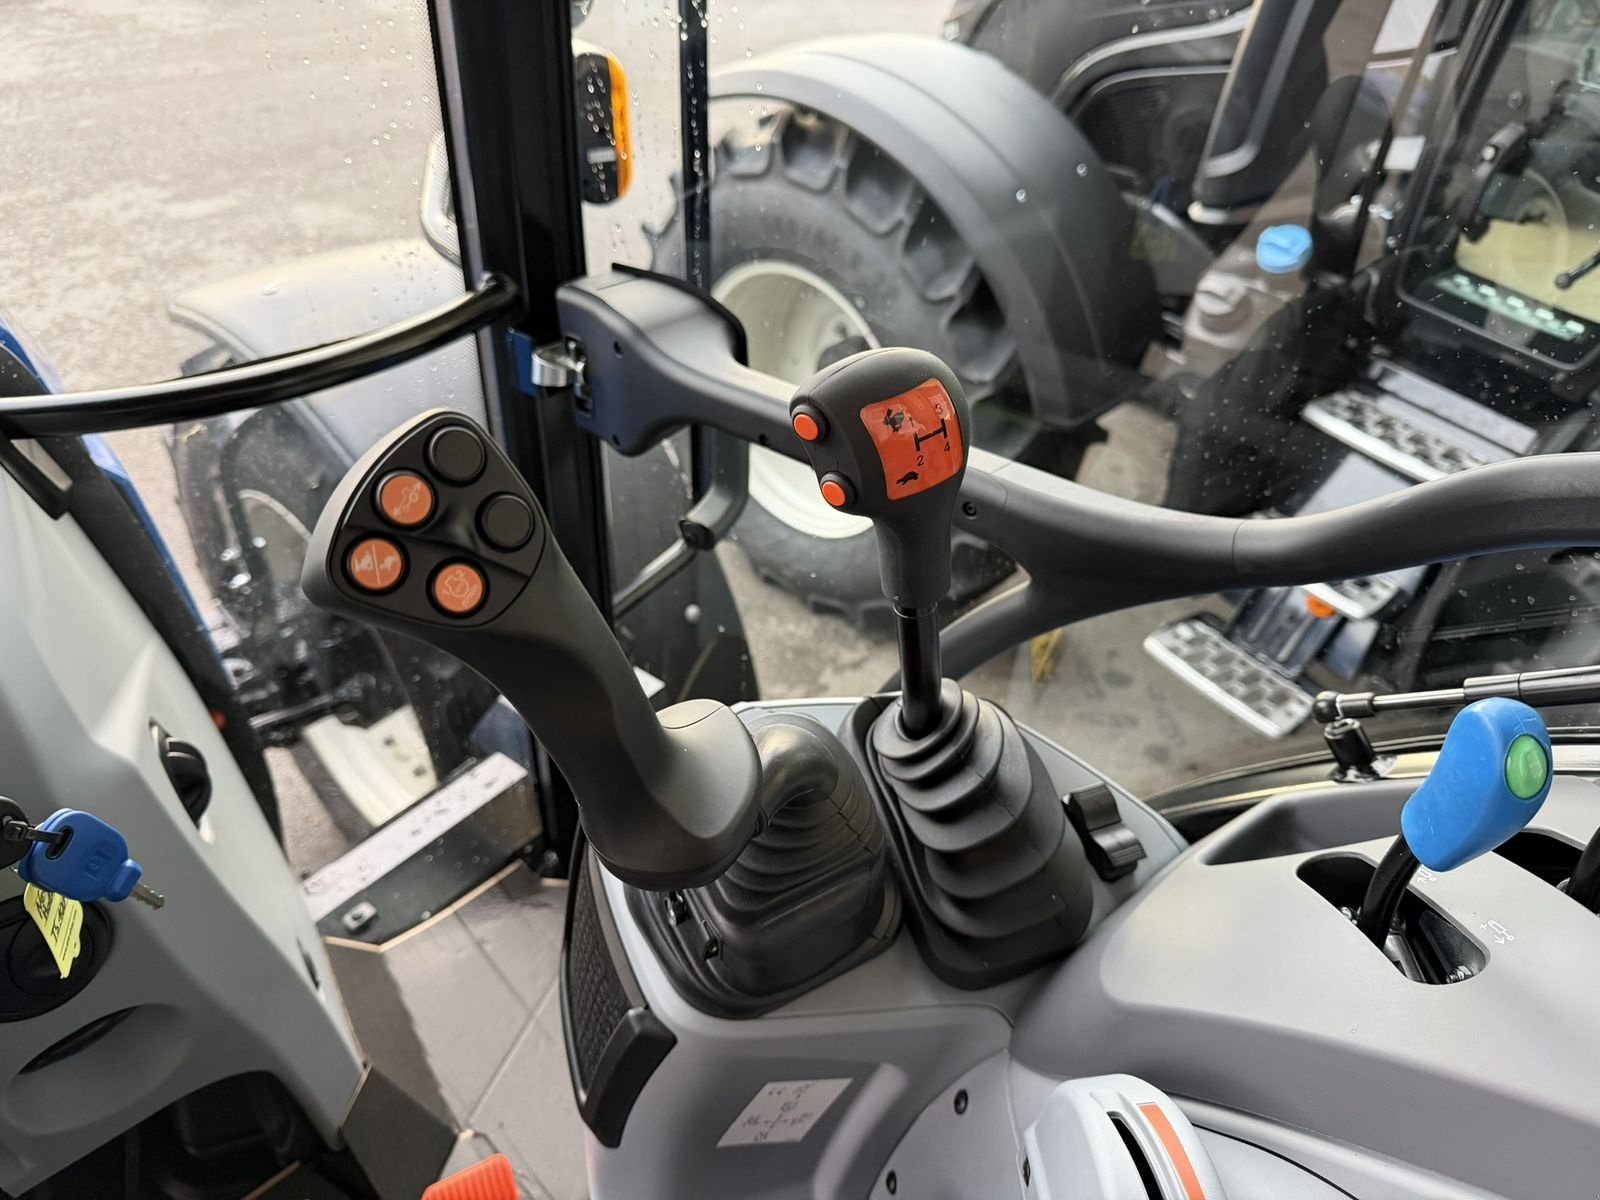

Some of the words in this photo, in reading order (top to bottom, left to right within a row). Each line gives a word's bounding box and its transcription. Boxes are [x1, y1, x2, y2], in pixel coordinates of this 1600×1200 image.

[935, 404, 943, 415] 3
[944, 442, 951, 452] 4
[916, 455, 925, 467] 2
